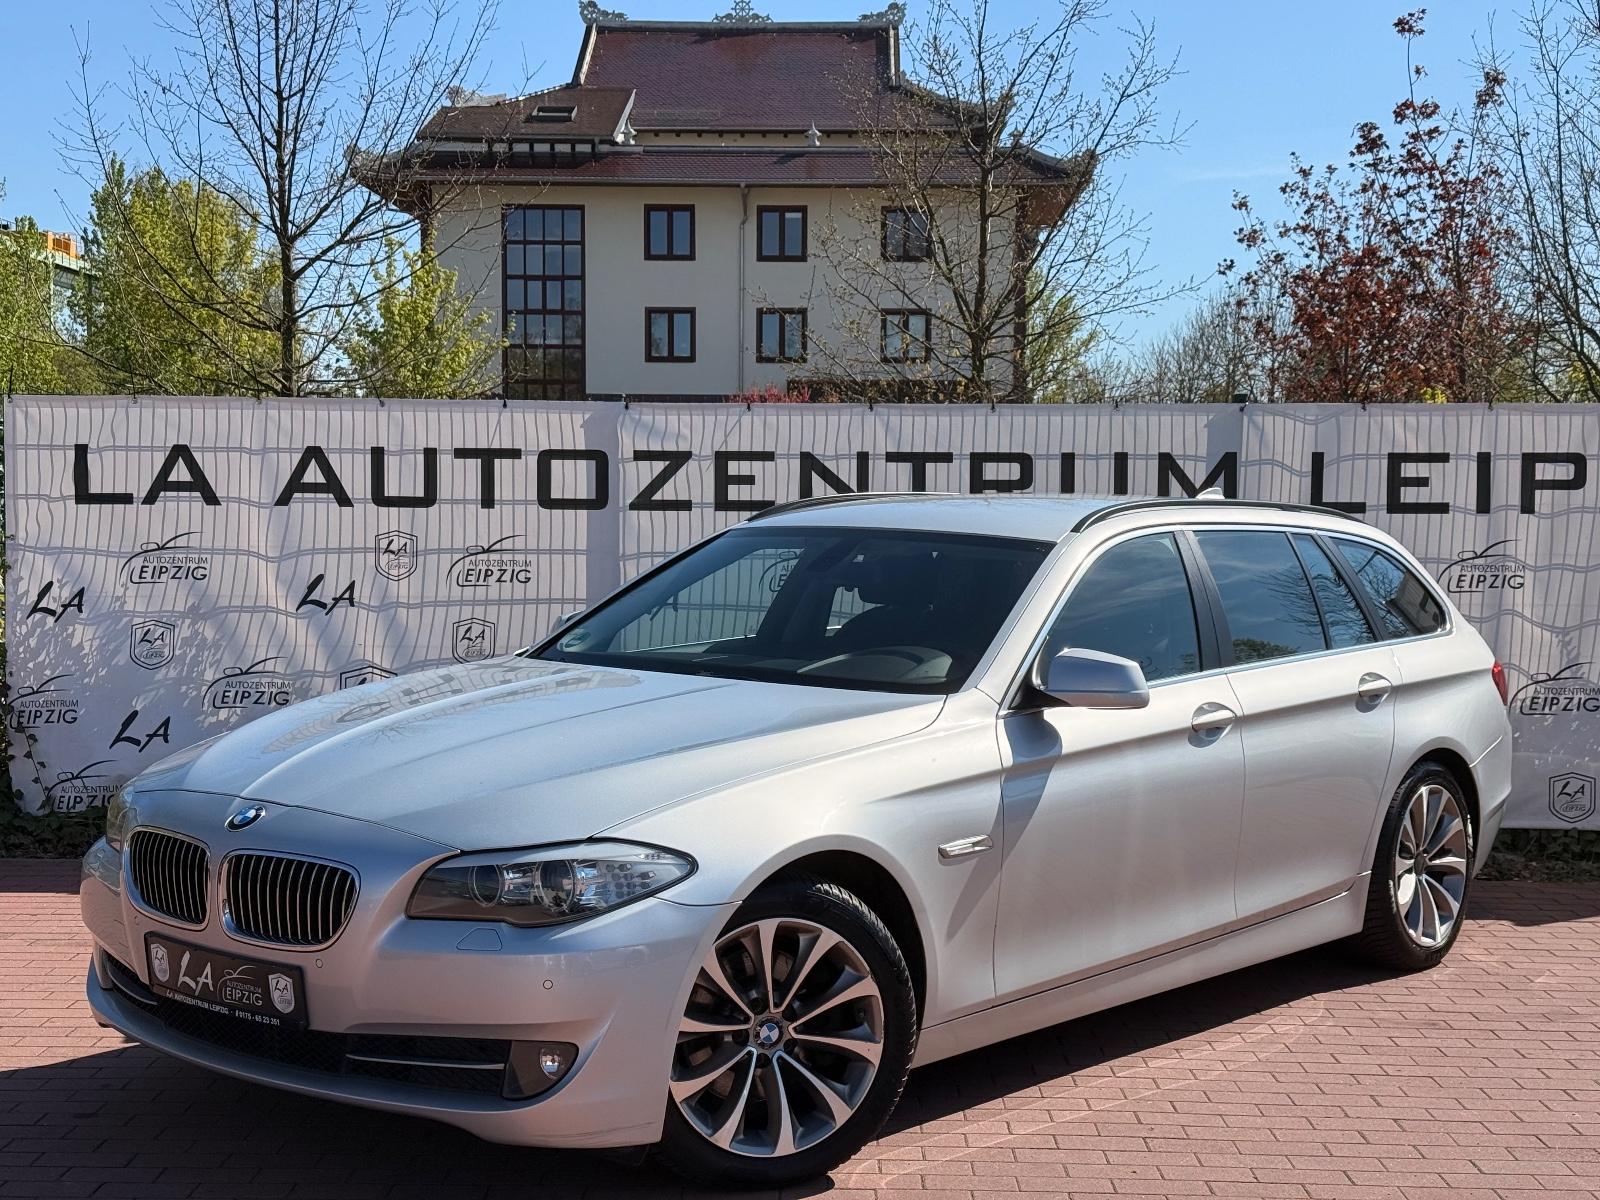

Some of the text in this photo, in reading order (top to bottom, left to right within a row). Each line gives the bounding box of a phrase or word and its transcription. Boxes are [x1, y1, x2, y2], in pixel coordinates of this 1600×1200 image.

[74, 443, 1588, 515] LA AUTOZENTRUM LEIP
[382, 538, 408, 557] LA
[143, 556, 208, 565] AUTOZENTRUM
[468, 559, 532, 568] AUTOZENTRUM
[1460, 564, 1526, 573] AUTOZENTRUM
[26, 580, 86, 623] LA
[296, 573, 356, 616] LA
[138, 627, 165, 647] LA
[459, 625, 486, 644] LA
[225, 680, 291, 690] AUTOZENTRUM
[20, 700, 79, 709] AUTOZENTRUM
[110, 710, 171, 752] LA
[1556, 780, 1585, 800] LA
[177, 950, 214, 996] LA
